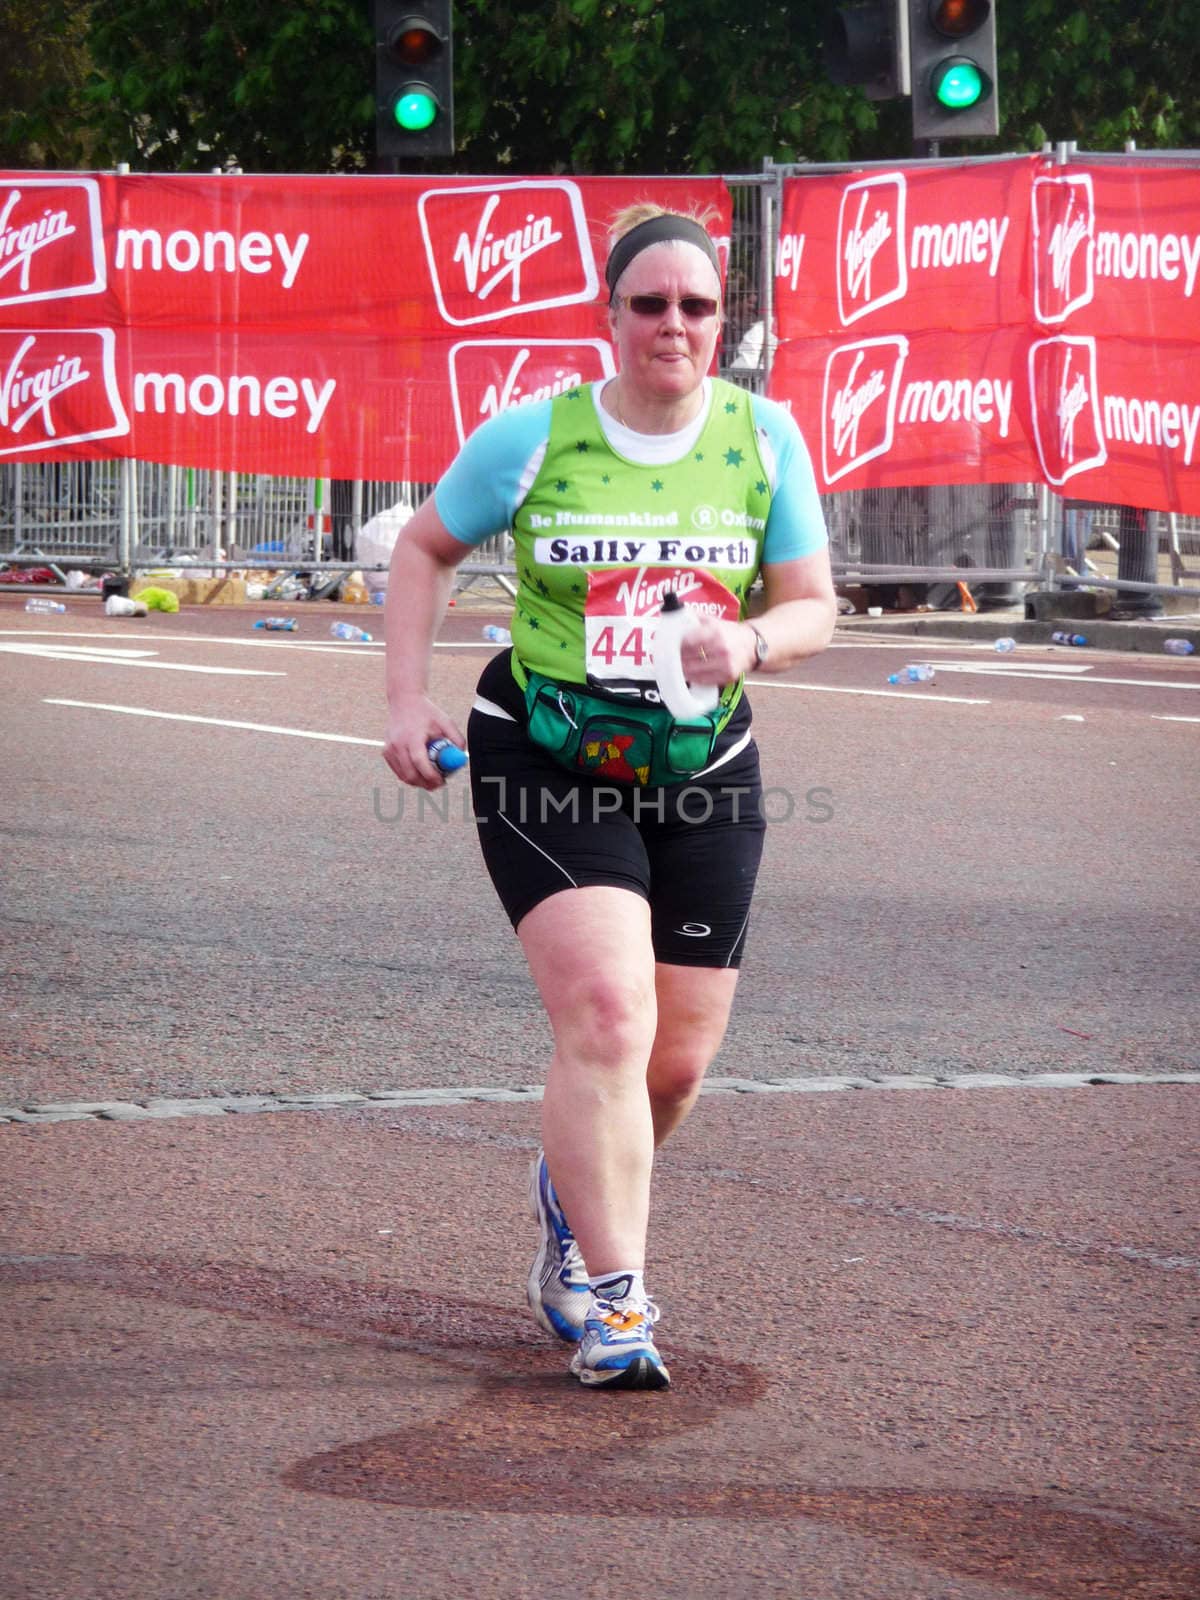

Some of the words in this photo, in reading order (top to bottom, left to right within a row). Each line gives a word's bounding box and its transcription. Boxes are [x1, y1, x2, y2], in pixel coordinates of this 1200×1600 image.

[115, 229, 309, 289] money
[453, 194, 562, 302] Virgin
[845, 190, 892, 301] Virgin
[910, 216, 1010, 277] money
[1096, 231, 1200, 297] money
[134, 372, 336, 434] money
[831, 350, 886, 458] Virgin
[898, 378, 1012, 438] money
[1103, 395, 1200, 466] money
[530, 513, 552, 529] Be
[555, 511, 679, 528] Humankind
[549, 539, 646, 563] Sally
[657, 540, 749, 565] Forth
[591, 625, 656, 667] 44
